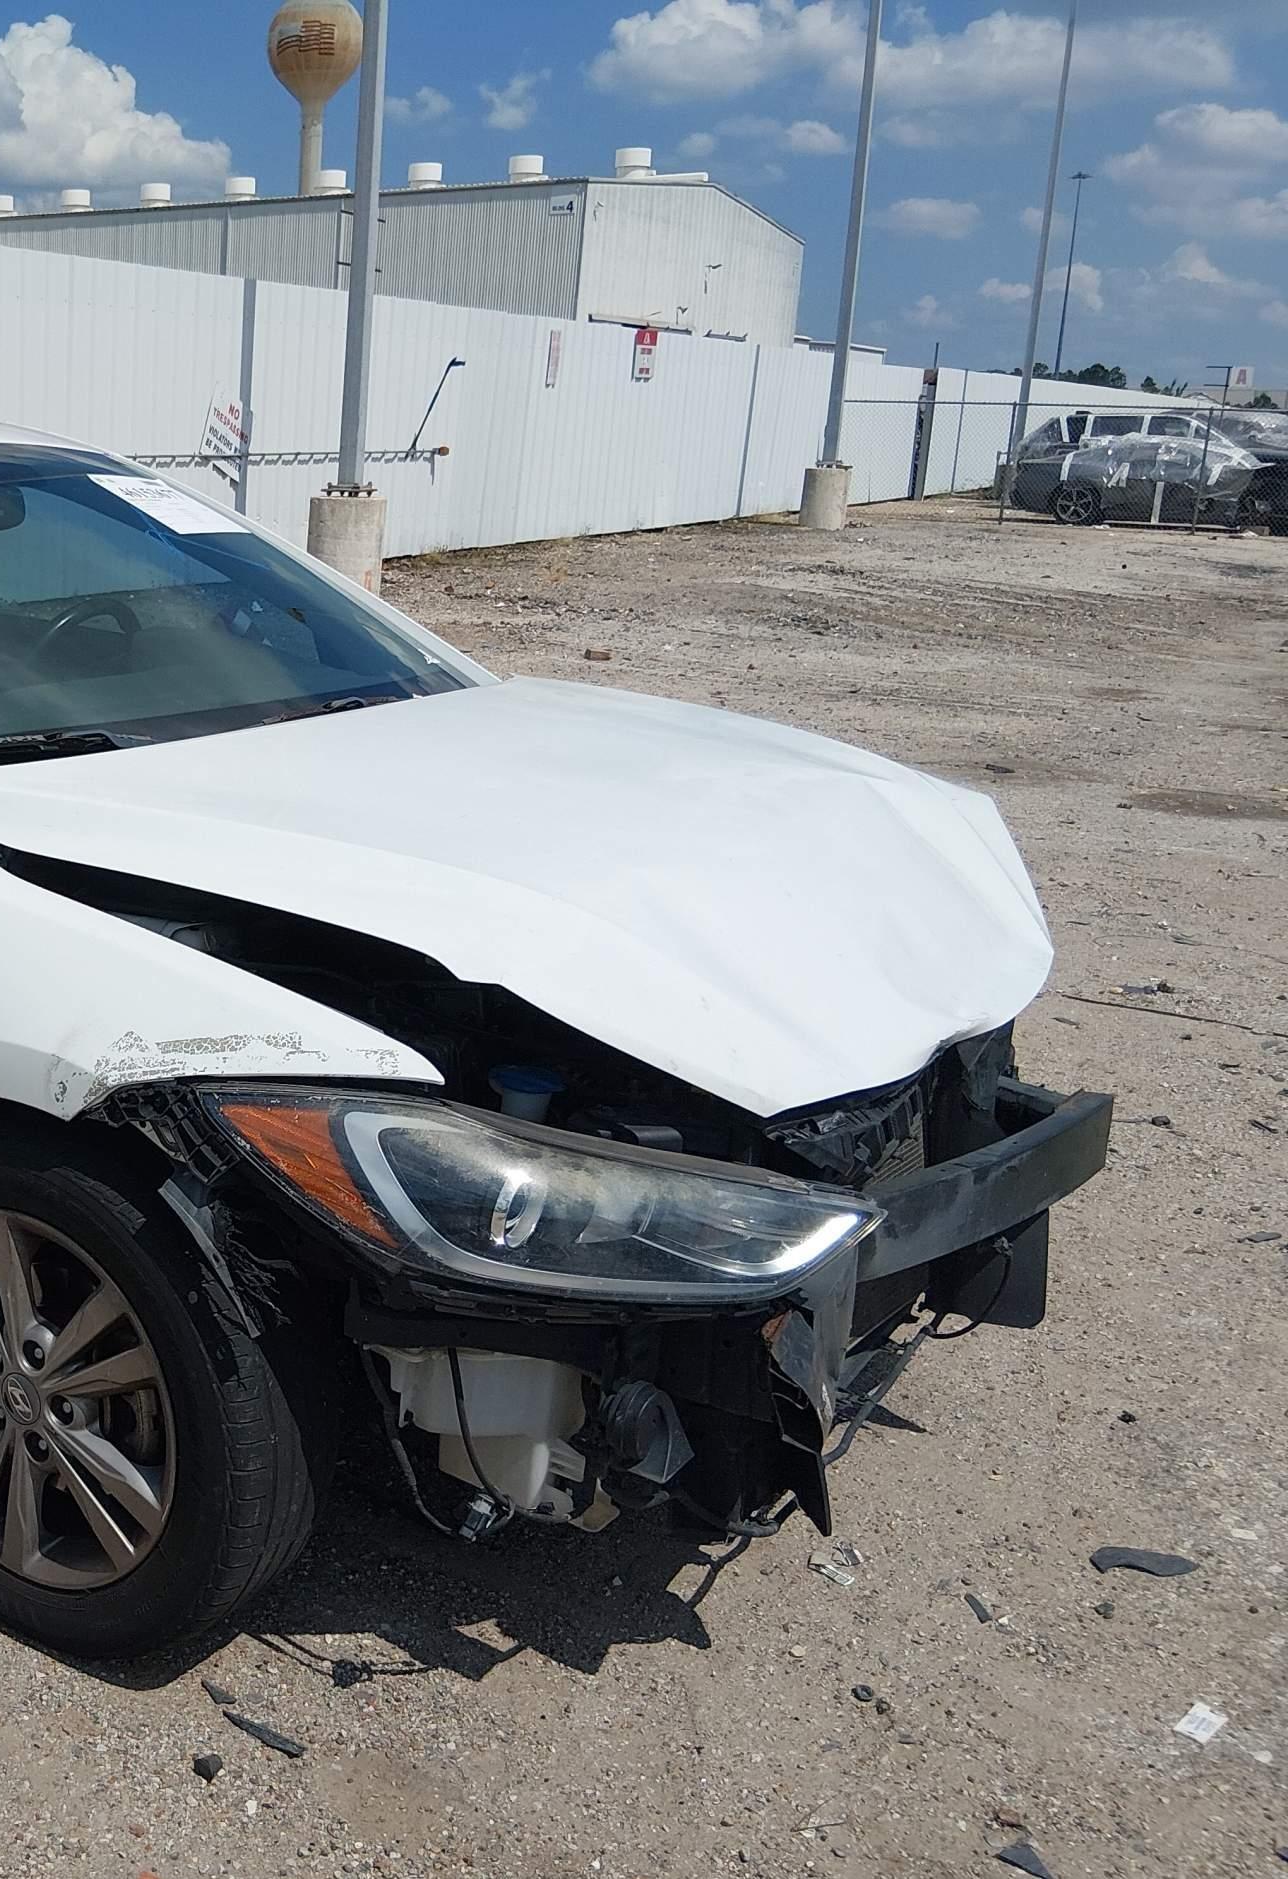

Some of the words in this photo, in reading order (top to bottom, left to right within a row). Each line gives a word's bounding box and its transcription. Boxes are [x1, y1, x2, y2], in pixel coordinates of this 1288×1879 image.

[566, 201, 574, 213] 4
[228, 403, 240, 420] NO
[205, 438, 212, 449] BE
[209, 425, 233, 451] VIOLATORS
